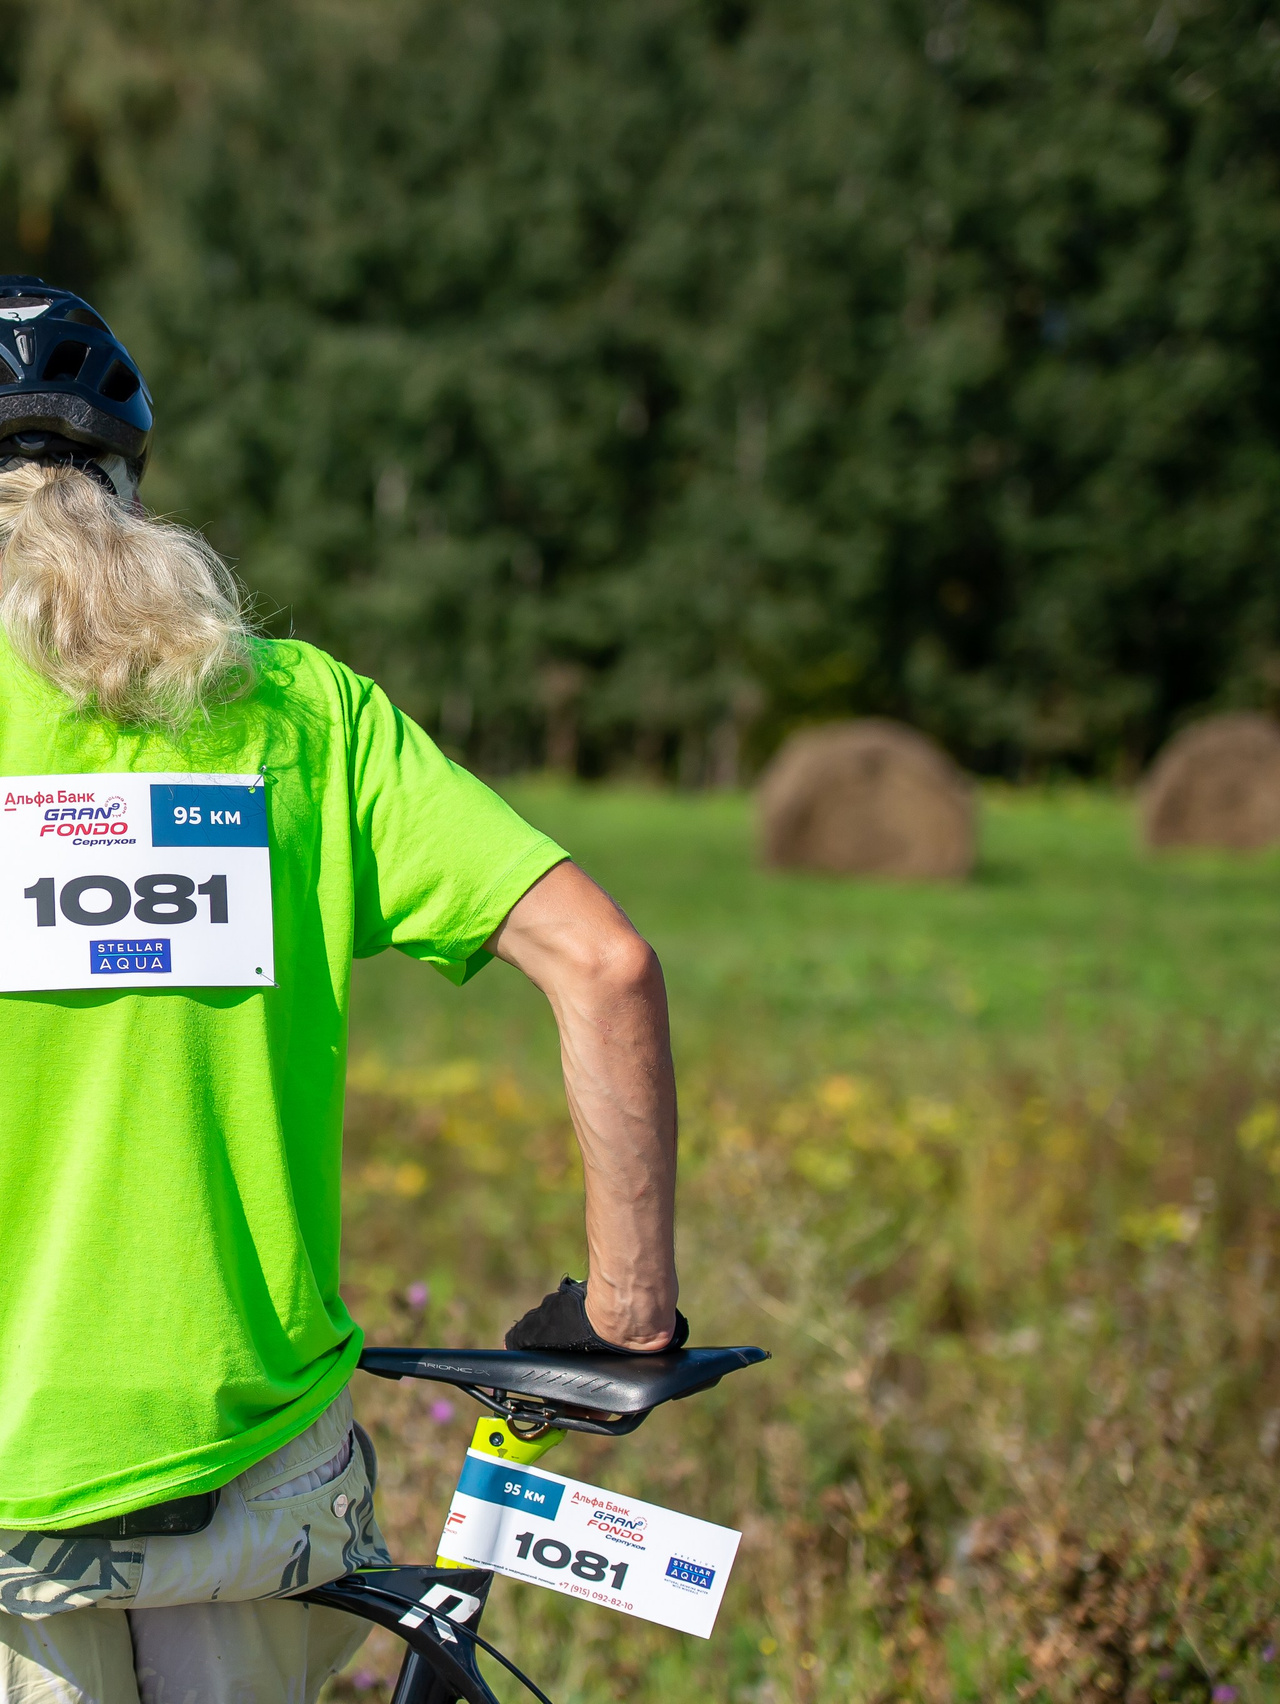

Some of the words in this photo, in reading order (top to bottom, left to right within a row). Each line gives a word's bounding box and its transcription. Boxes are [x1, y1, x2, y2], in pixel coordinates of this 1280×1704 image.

[4, 791, 54, 809] Альфа
[57, 790, 96, 804] Банк
[44, 807, 112, 821] GRAN
[173, 806, 202, 825] 95
[40, 822, 128, 837] FONDO
[72, 838, 137, 847] Серпухов
[24, 873, 229, 927] 1081
[97, 942, 163, 953] STELLAR
[99, 956, 163, 970] AQUA
[503, 1481, 522, 1496] 95
[571, 1491, 604, 1508] Альфа
[605, 1501, 630, 1516] Банк
[593, 1510, 638, 1529] GRAN
[587, 1519, 644, 1542] FONDO
[605, 1533, 646, 1551] Серпухов
[515, 1531, 629, 1591] 1081
[672, 1560, 711, 1577] STELLAR
[670, 1568, 707, 1586] AQUA
[558, 1581, 569, 1590] +7
[570, 1584, 590, 1597] (915)
[592, 1591, 634, 1611] 092-82-10
